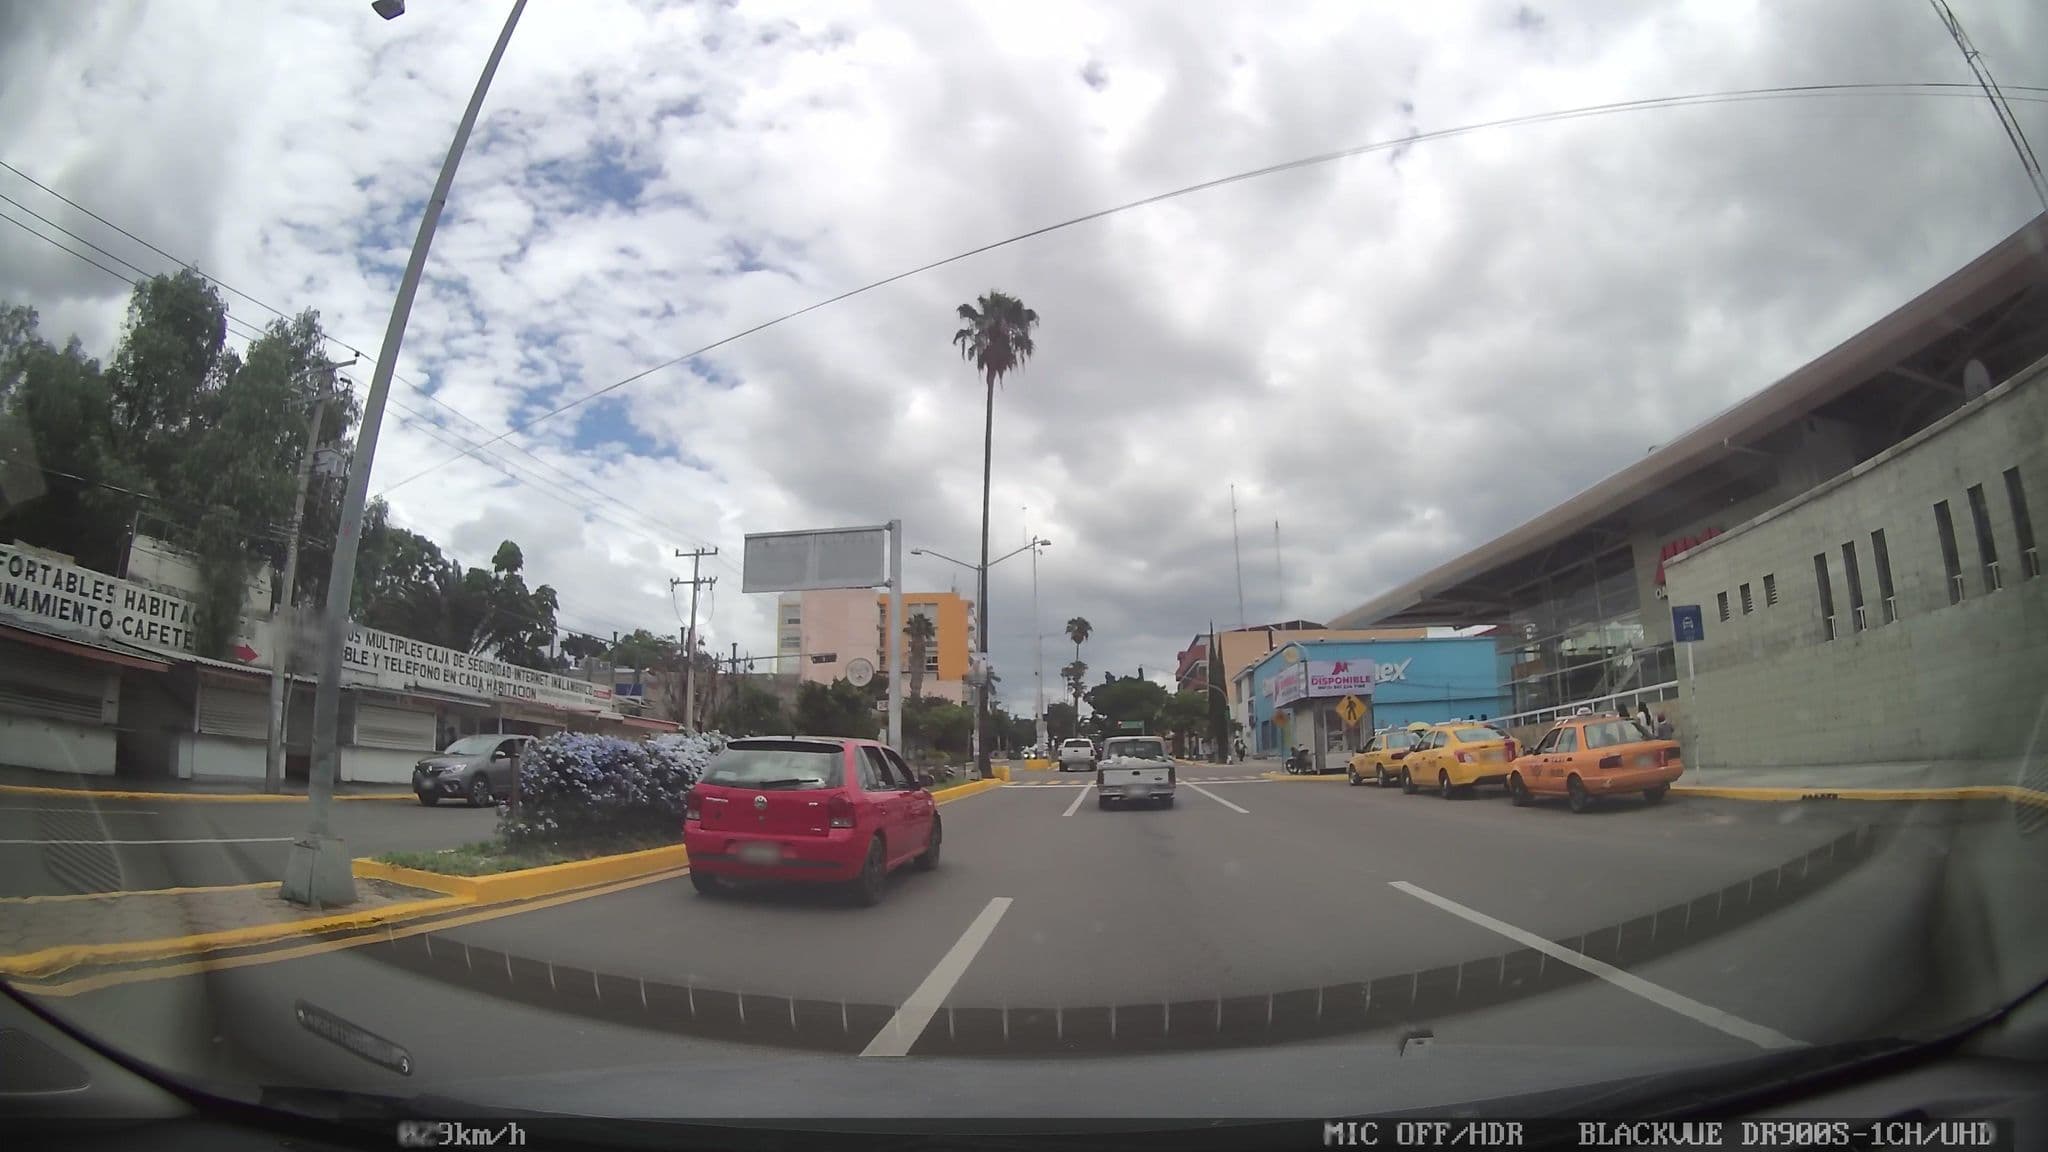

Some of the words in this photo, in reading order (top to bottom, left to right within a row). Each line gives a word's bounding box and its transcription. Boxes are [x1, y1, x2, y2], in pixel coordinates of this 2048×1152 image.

[366, 632, 422, 658] MULTIPLES
[427, 648, 449, 666] CAJA
[453, 653, 465, 668] DE
[373, 652, 379, 668] Y
[384, 656, 440, 681] TELEFONO
[444, 669, 456, 684] EN
[459, 673, 483, 690] CADA
[1311, 675, 1371, 686] DISPONIBLE
